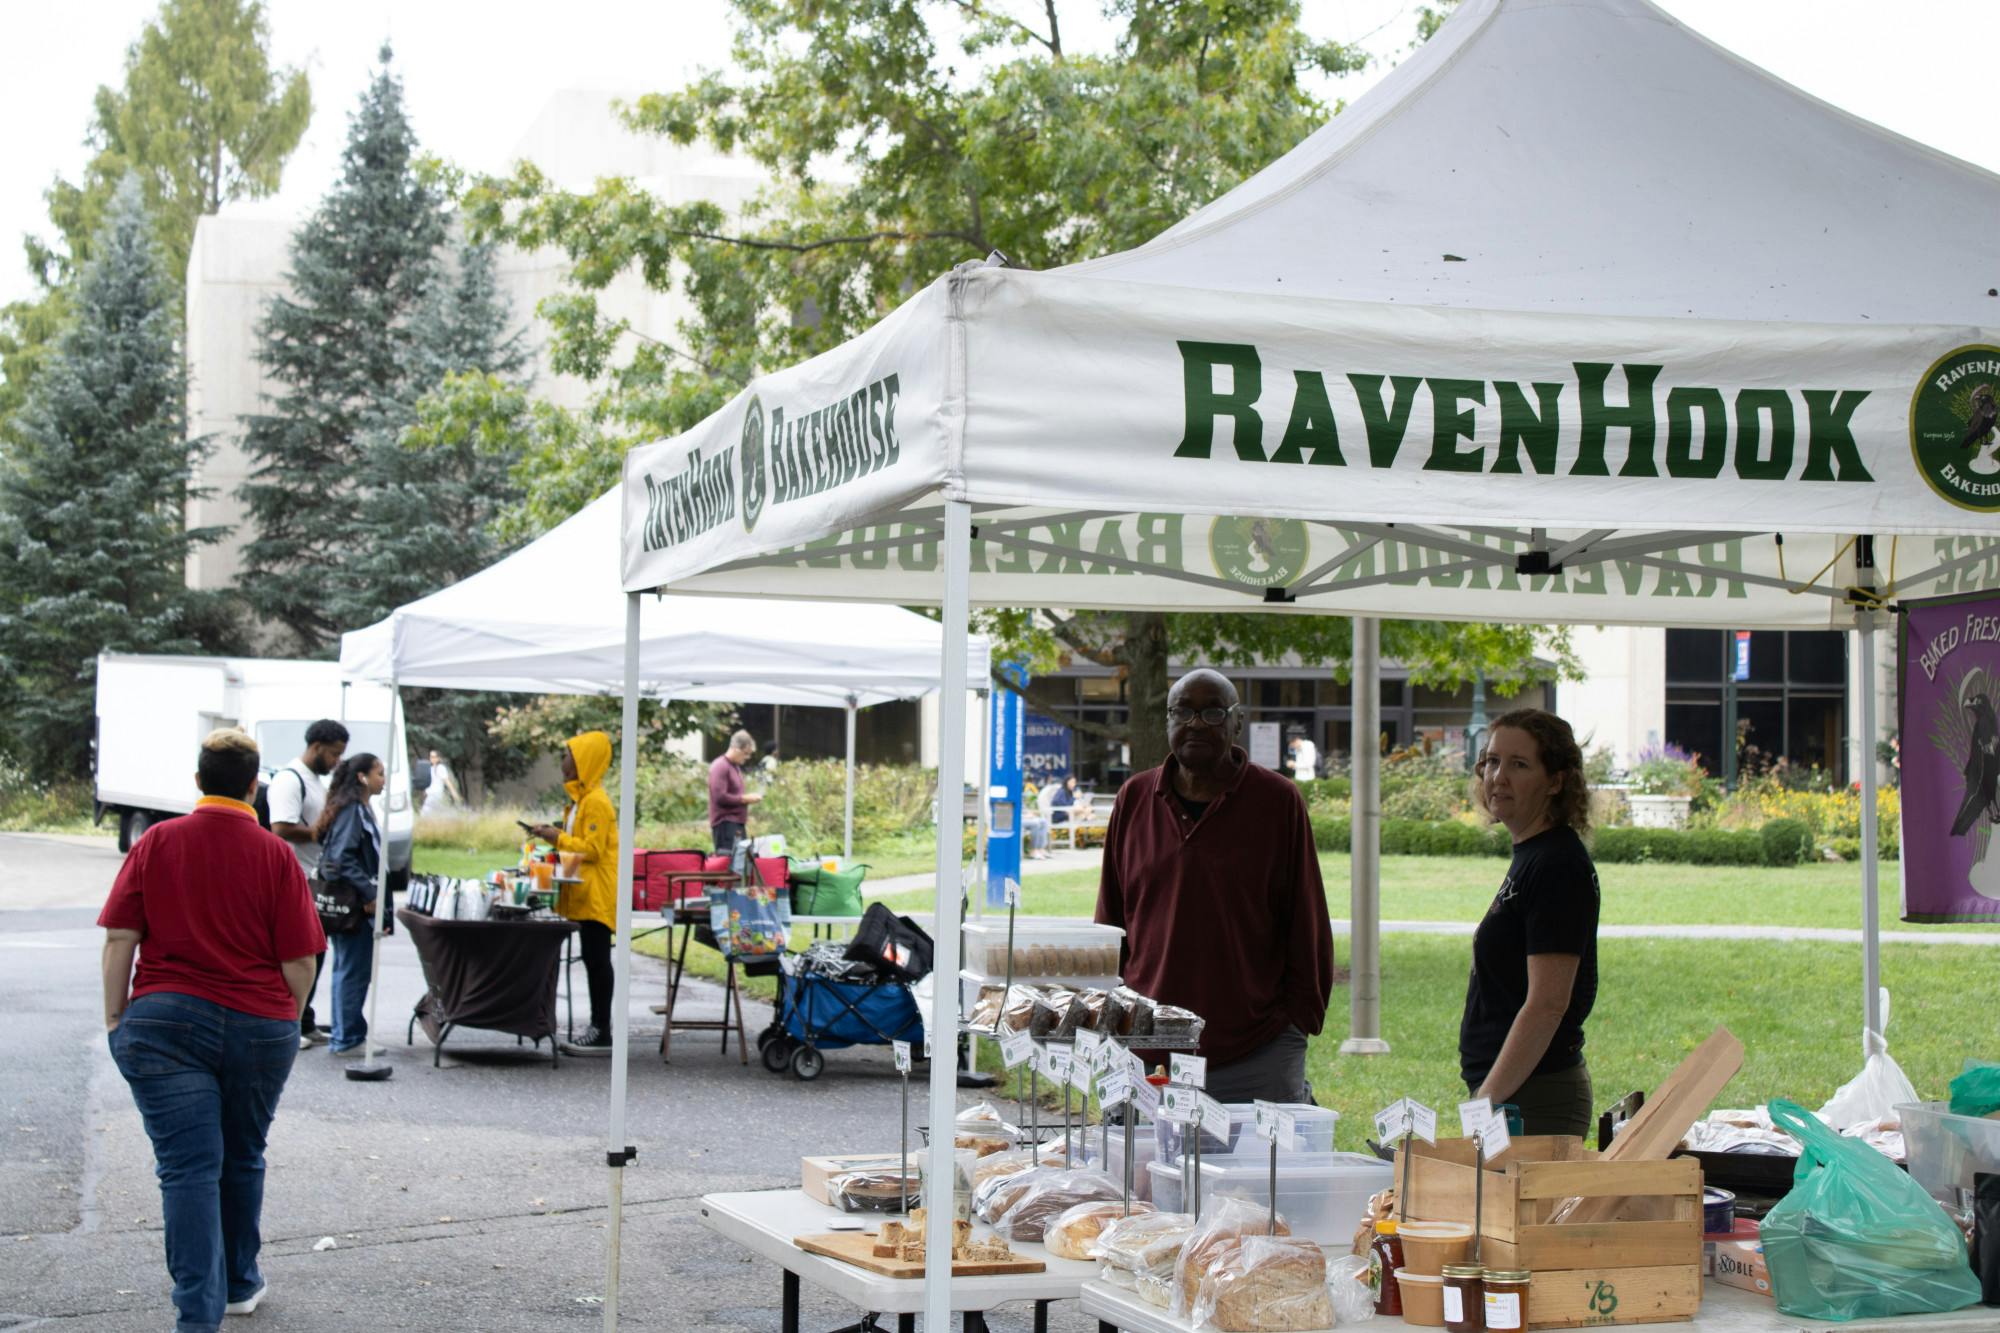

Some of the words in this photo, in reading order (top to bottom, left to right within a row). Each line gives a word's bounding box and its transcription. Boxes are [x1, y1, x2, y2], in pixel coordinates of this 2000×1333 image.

[643, 446, 735, 552] RAVENHOOK
[771, 372, 900, 505] BAKEHOUSE
[1173, 340, 1876, 483] RAVENHOOK
[1920, 626, 1960, 681] BAKED
